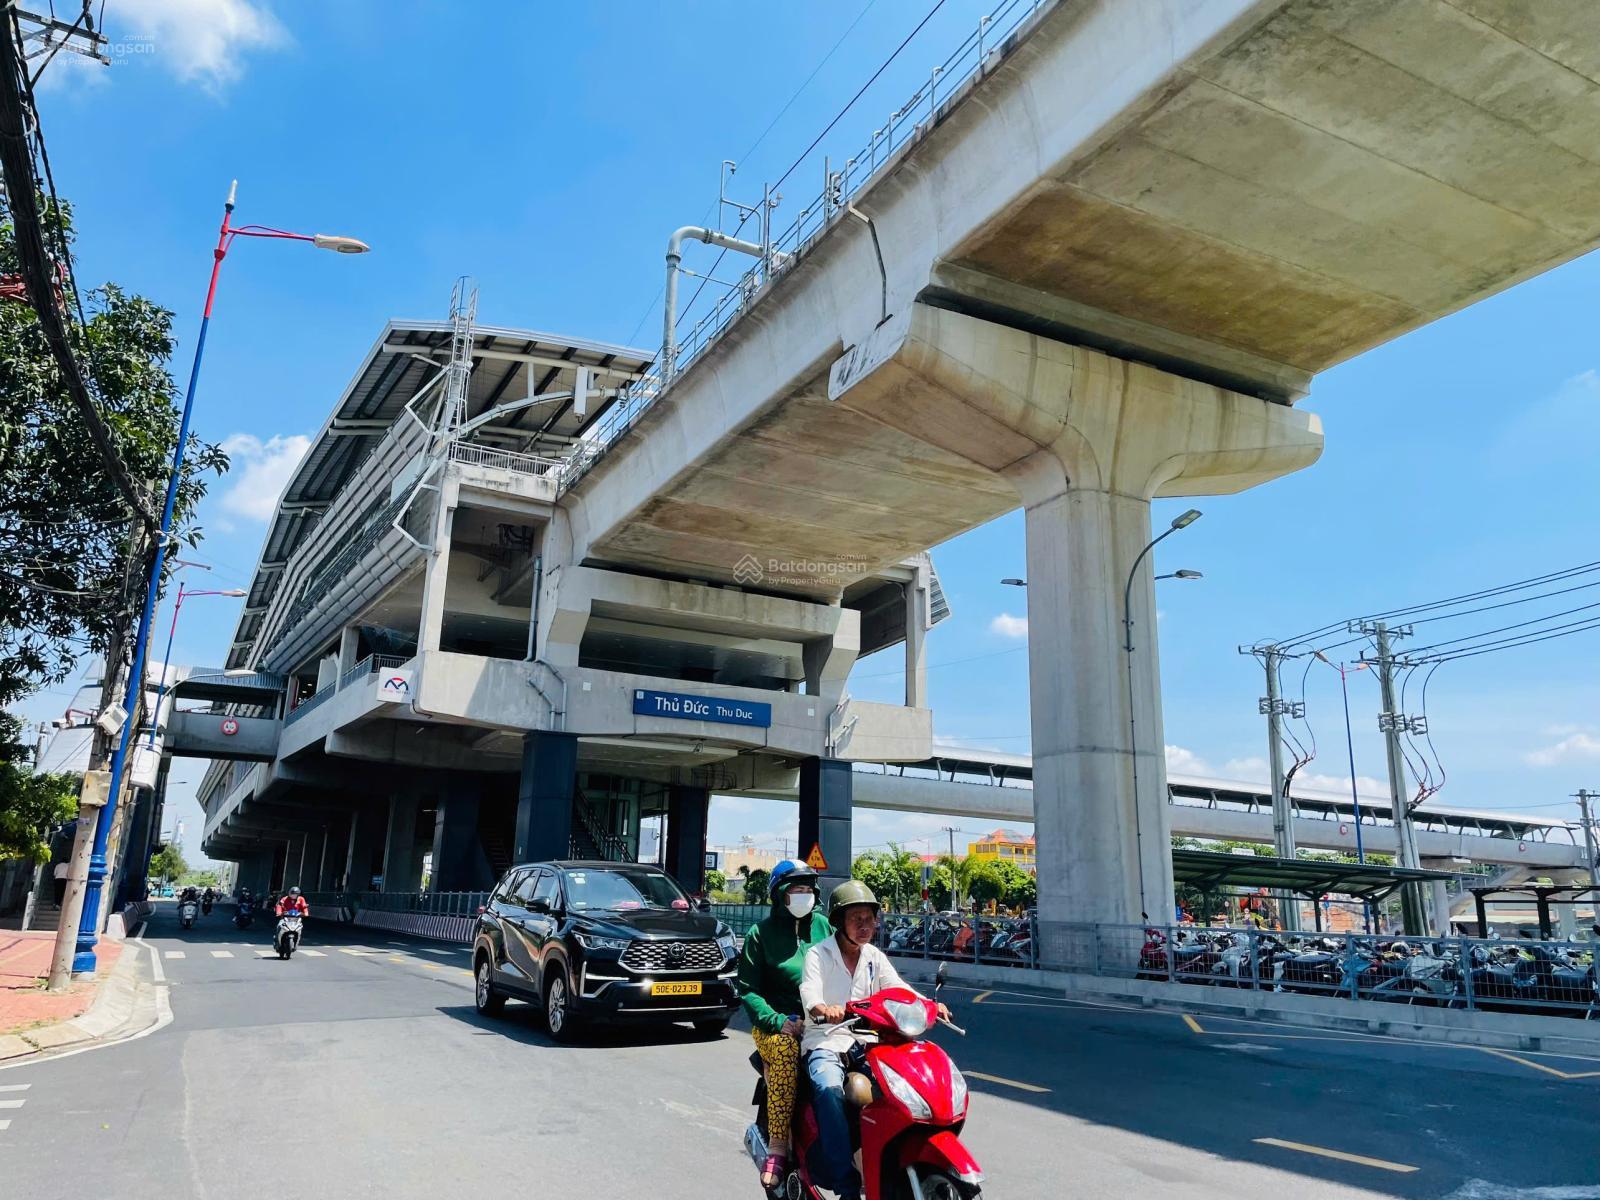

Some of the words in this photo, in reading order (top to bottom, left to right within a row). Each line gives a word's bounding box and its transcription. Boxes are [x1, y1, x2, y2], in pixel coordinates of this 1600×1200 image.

[654, 696, 680, 713] Thủ
[683, 700, 710, 715] Đức
[716, 705, 733, 717] Thu
[735, 708, 753, 720] Duc
[655, 985, 698, 993] 50E-023.39
